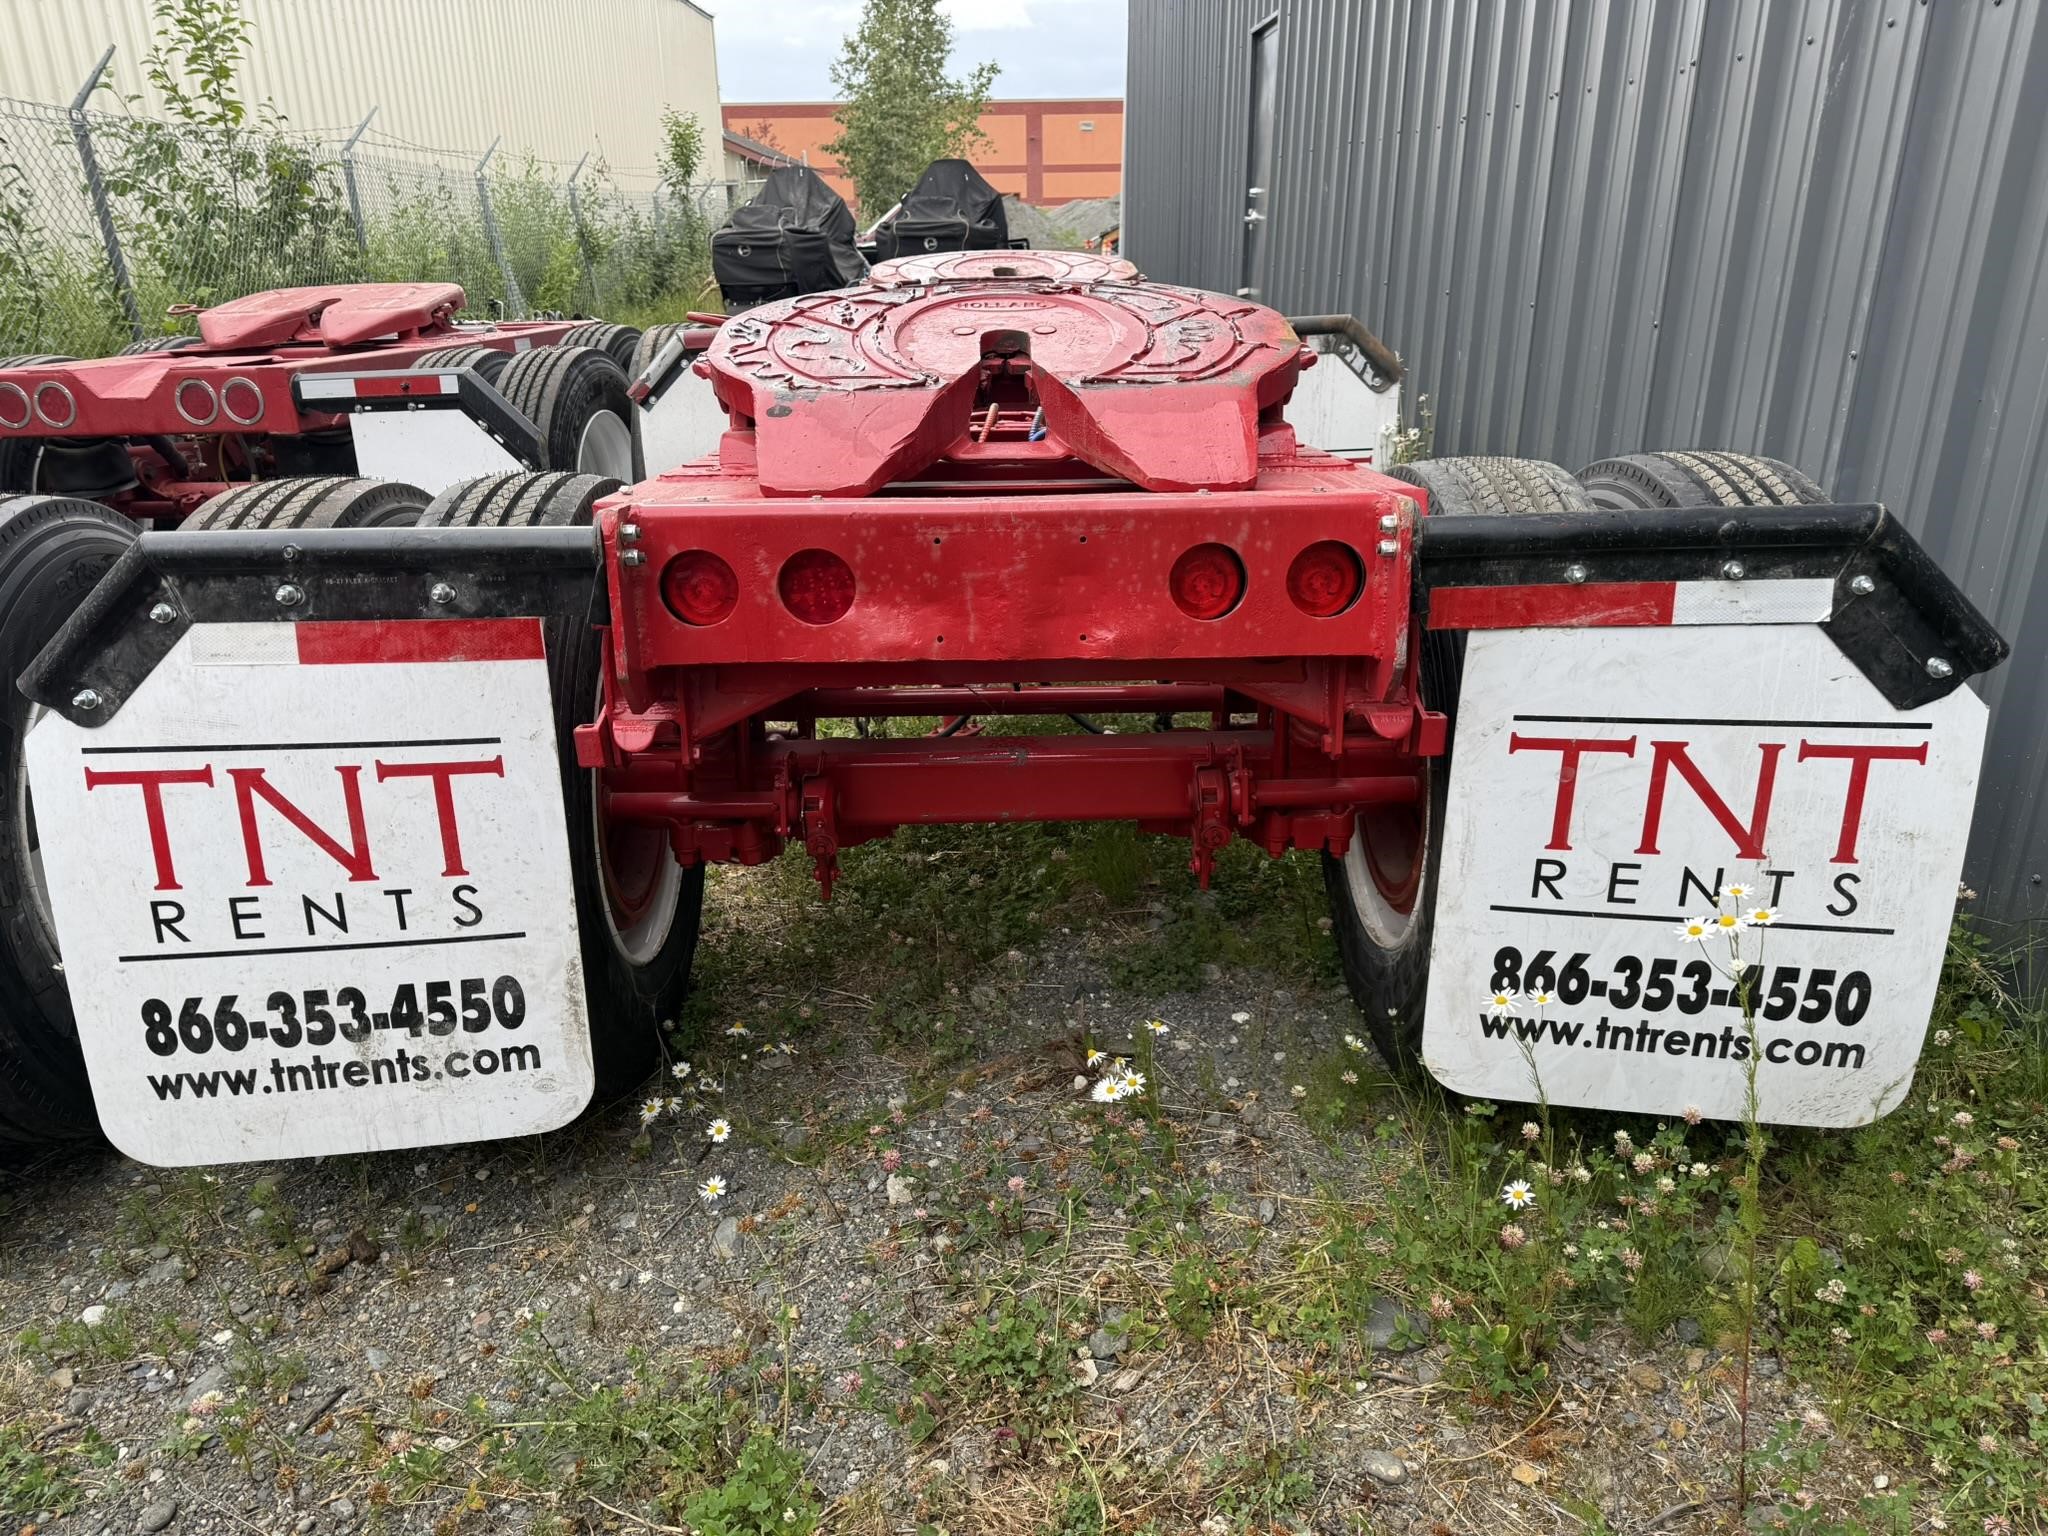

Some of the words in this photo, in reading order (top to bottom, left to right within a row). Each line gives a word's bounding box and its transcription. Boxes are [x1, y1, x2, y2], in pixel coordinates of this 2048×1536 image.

[84, 754, 505, 891] TNT
[1508, 731, 1929, 865] TNT
[149, 884, 483, 944] RENTS
[1531, 858, 1861, 917] RENTS
[141, 975, 526, 1057] 866-353-4550
[1489, 946, 1872, 1027] 866-353-4550
[146, 1044, 541, 1101] www.tntrents.com
[1479, 1013, 1866, 1069] www.tntrentscom
